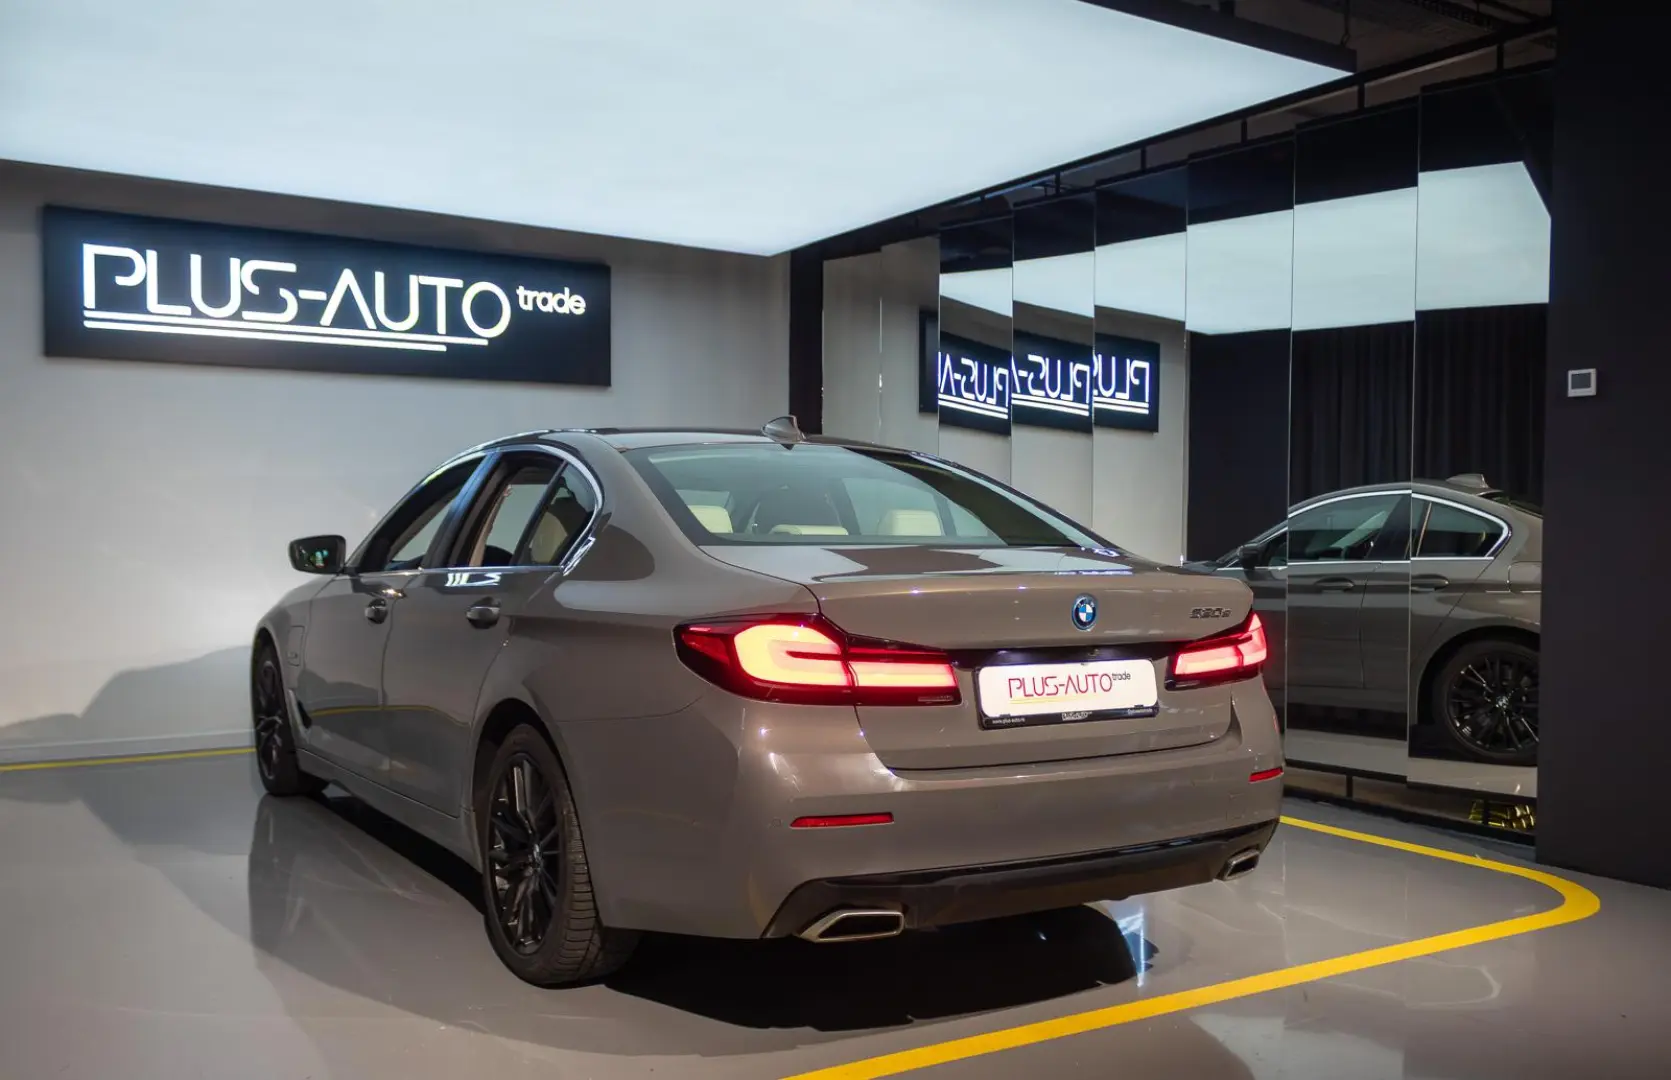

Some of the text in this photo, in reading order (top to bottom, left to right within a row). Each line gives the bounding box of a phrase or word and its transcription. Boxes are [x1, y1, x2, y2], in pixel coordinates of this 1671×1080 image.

[82, 242, 587, 339] PLUS-AUTO trade
[1008, 670, 1132, 699] PLUS-AUTO trade
